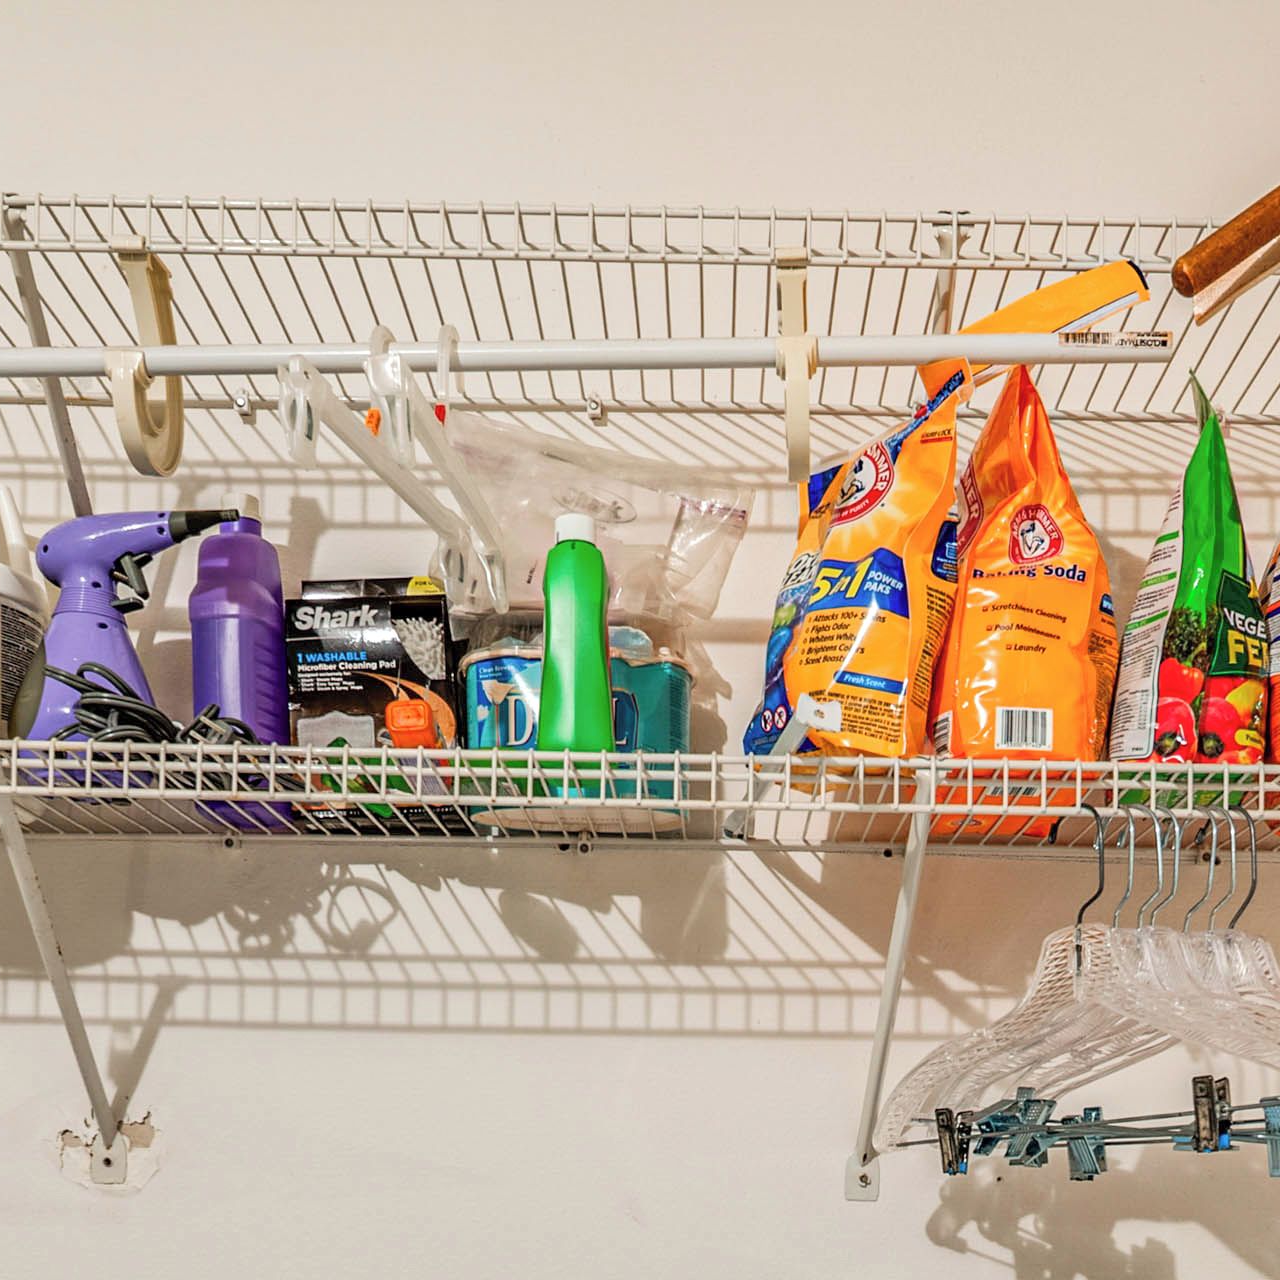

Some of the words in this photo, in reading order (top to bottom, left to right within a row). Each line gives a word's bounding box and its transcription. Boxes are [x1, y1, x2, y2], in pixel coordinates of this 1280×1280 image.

[1043, 564, 1087, 583] Soda
[863, 581, 892, 595] PAKS
[867, 570, 904, 592] POWER
[294, 604, 378, 631] Shark
[1035, 608, 1067, 623] Cleaning
[810, 624, 831, 634] Fights
[832, 622, 850, 632] Odor
[994, 623, 1013, 631] Pool
[1223, 607, 1267, 639] VEGE
[1013, 643, 1047, 654] Laundry
[305, 651, 367, 662] WASHABLE
[297, 662, 337, 672] Microfiber
[338, 660, 377, 671] Cleaning
[379, 659, 396, 668] Pad
[844, 675, 864, 685] Fresh
[865, 678, 886, 689] Scent
